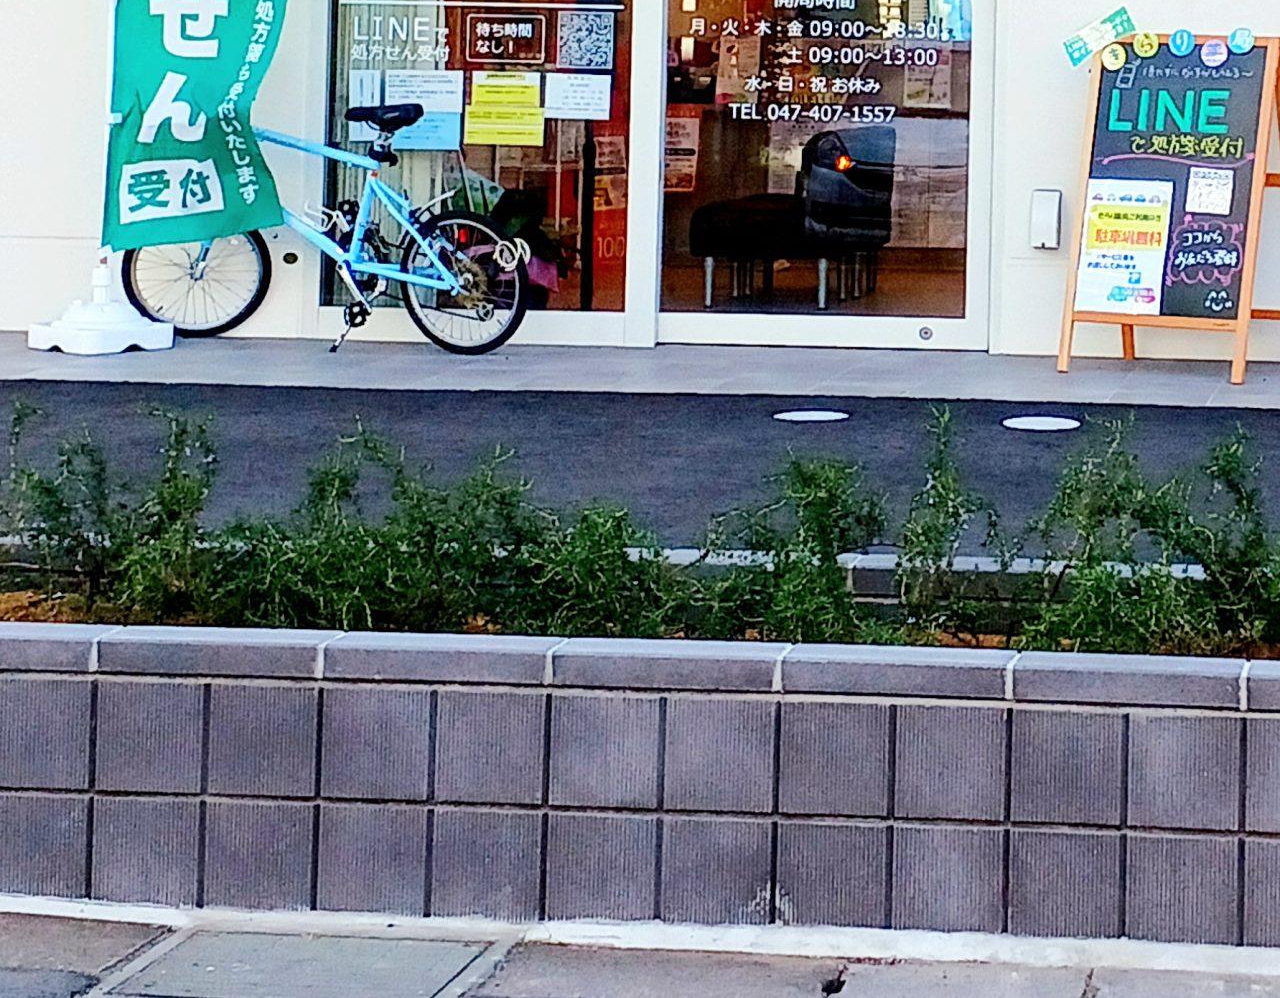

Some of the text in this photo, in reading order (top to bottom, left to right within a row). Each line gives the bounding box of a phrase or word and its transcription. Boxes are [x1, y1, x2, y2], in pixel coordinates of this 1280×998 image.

[475, 22, 533, 39] 待ち時間
[809, 19, 939, 40] 09:00〜8:30
[350, 44, 450, 63] 処方せん受付
[787, 46, 803, 64] 土
[1107, 88, 1231, 134] LINE
[127, 168, 213, 213] 受付
